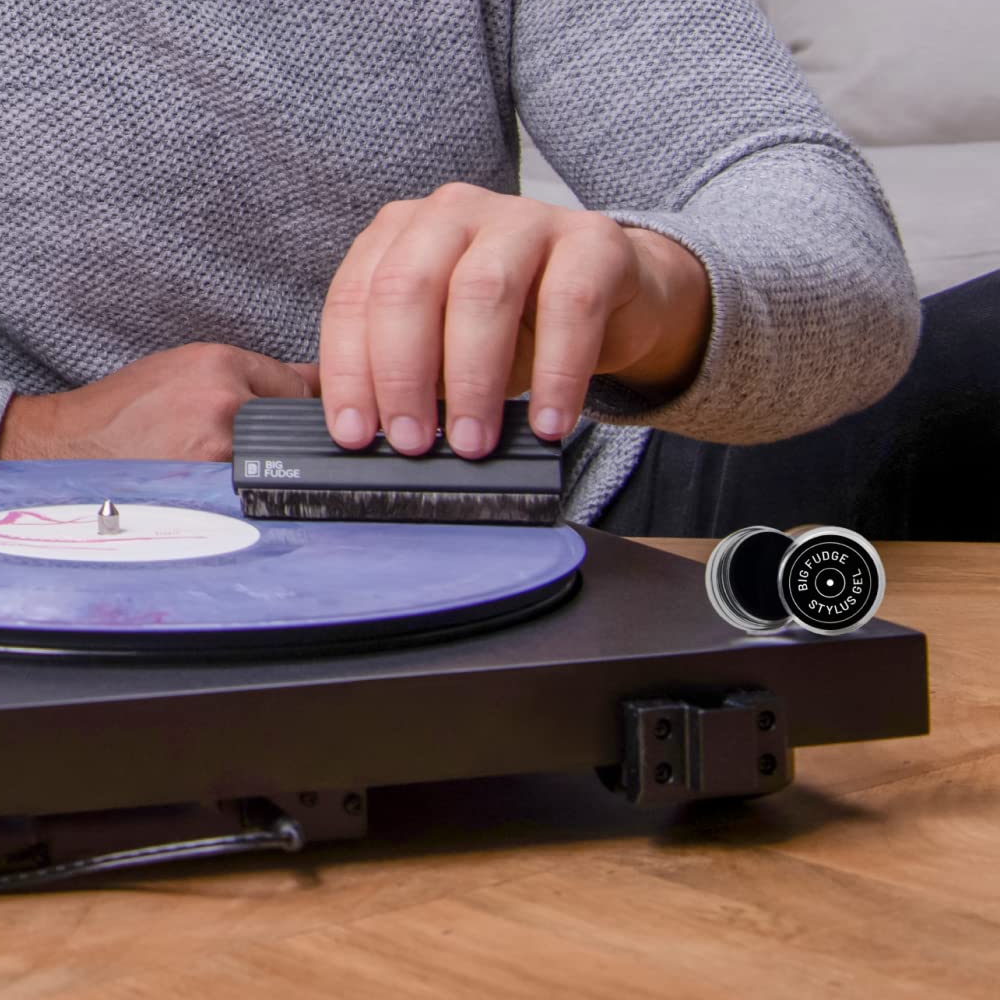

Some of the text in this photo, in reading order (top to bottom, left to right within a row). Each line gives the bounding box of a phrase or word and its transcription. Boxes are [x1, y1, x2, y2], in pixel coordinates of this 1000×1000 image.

[264, 469, 300, 478] FUDGE
[265, 460, 283, 469] BIG
[798, 550, 849, 592] BIG FUDGE
[808, 568, 864, 615] STYLUS GEL
